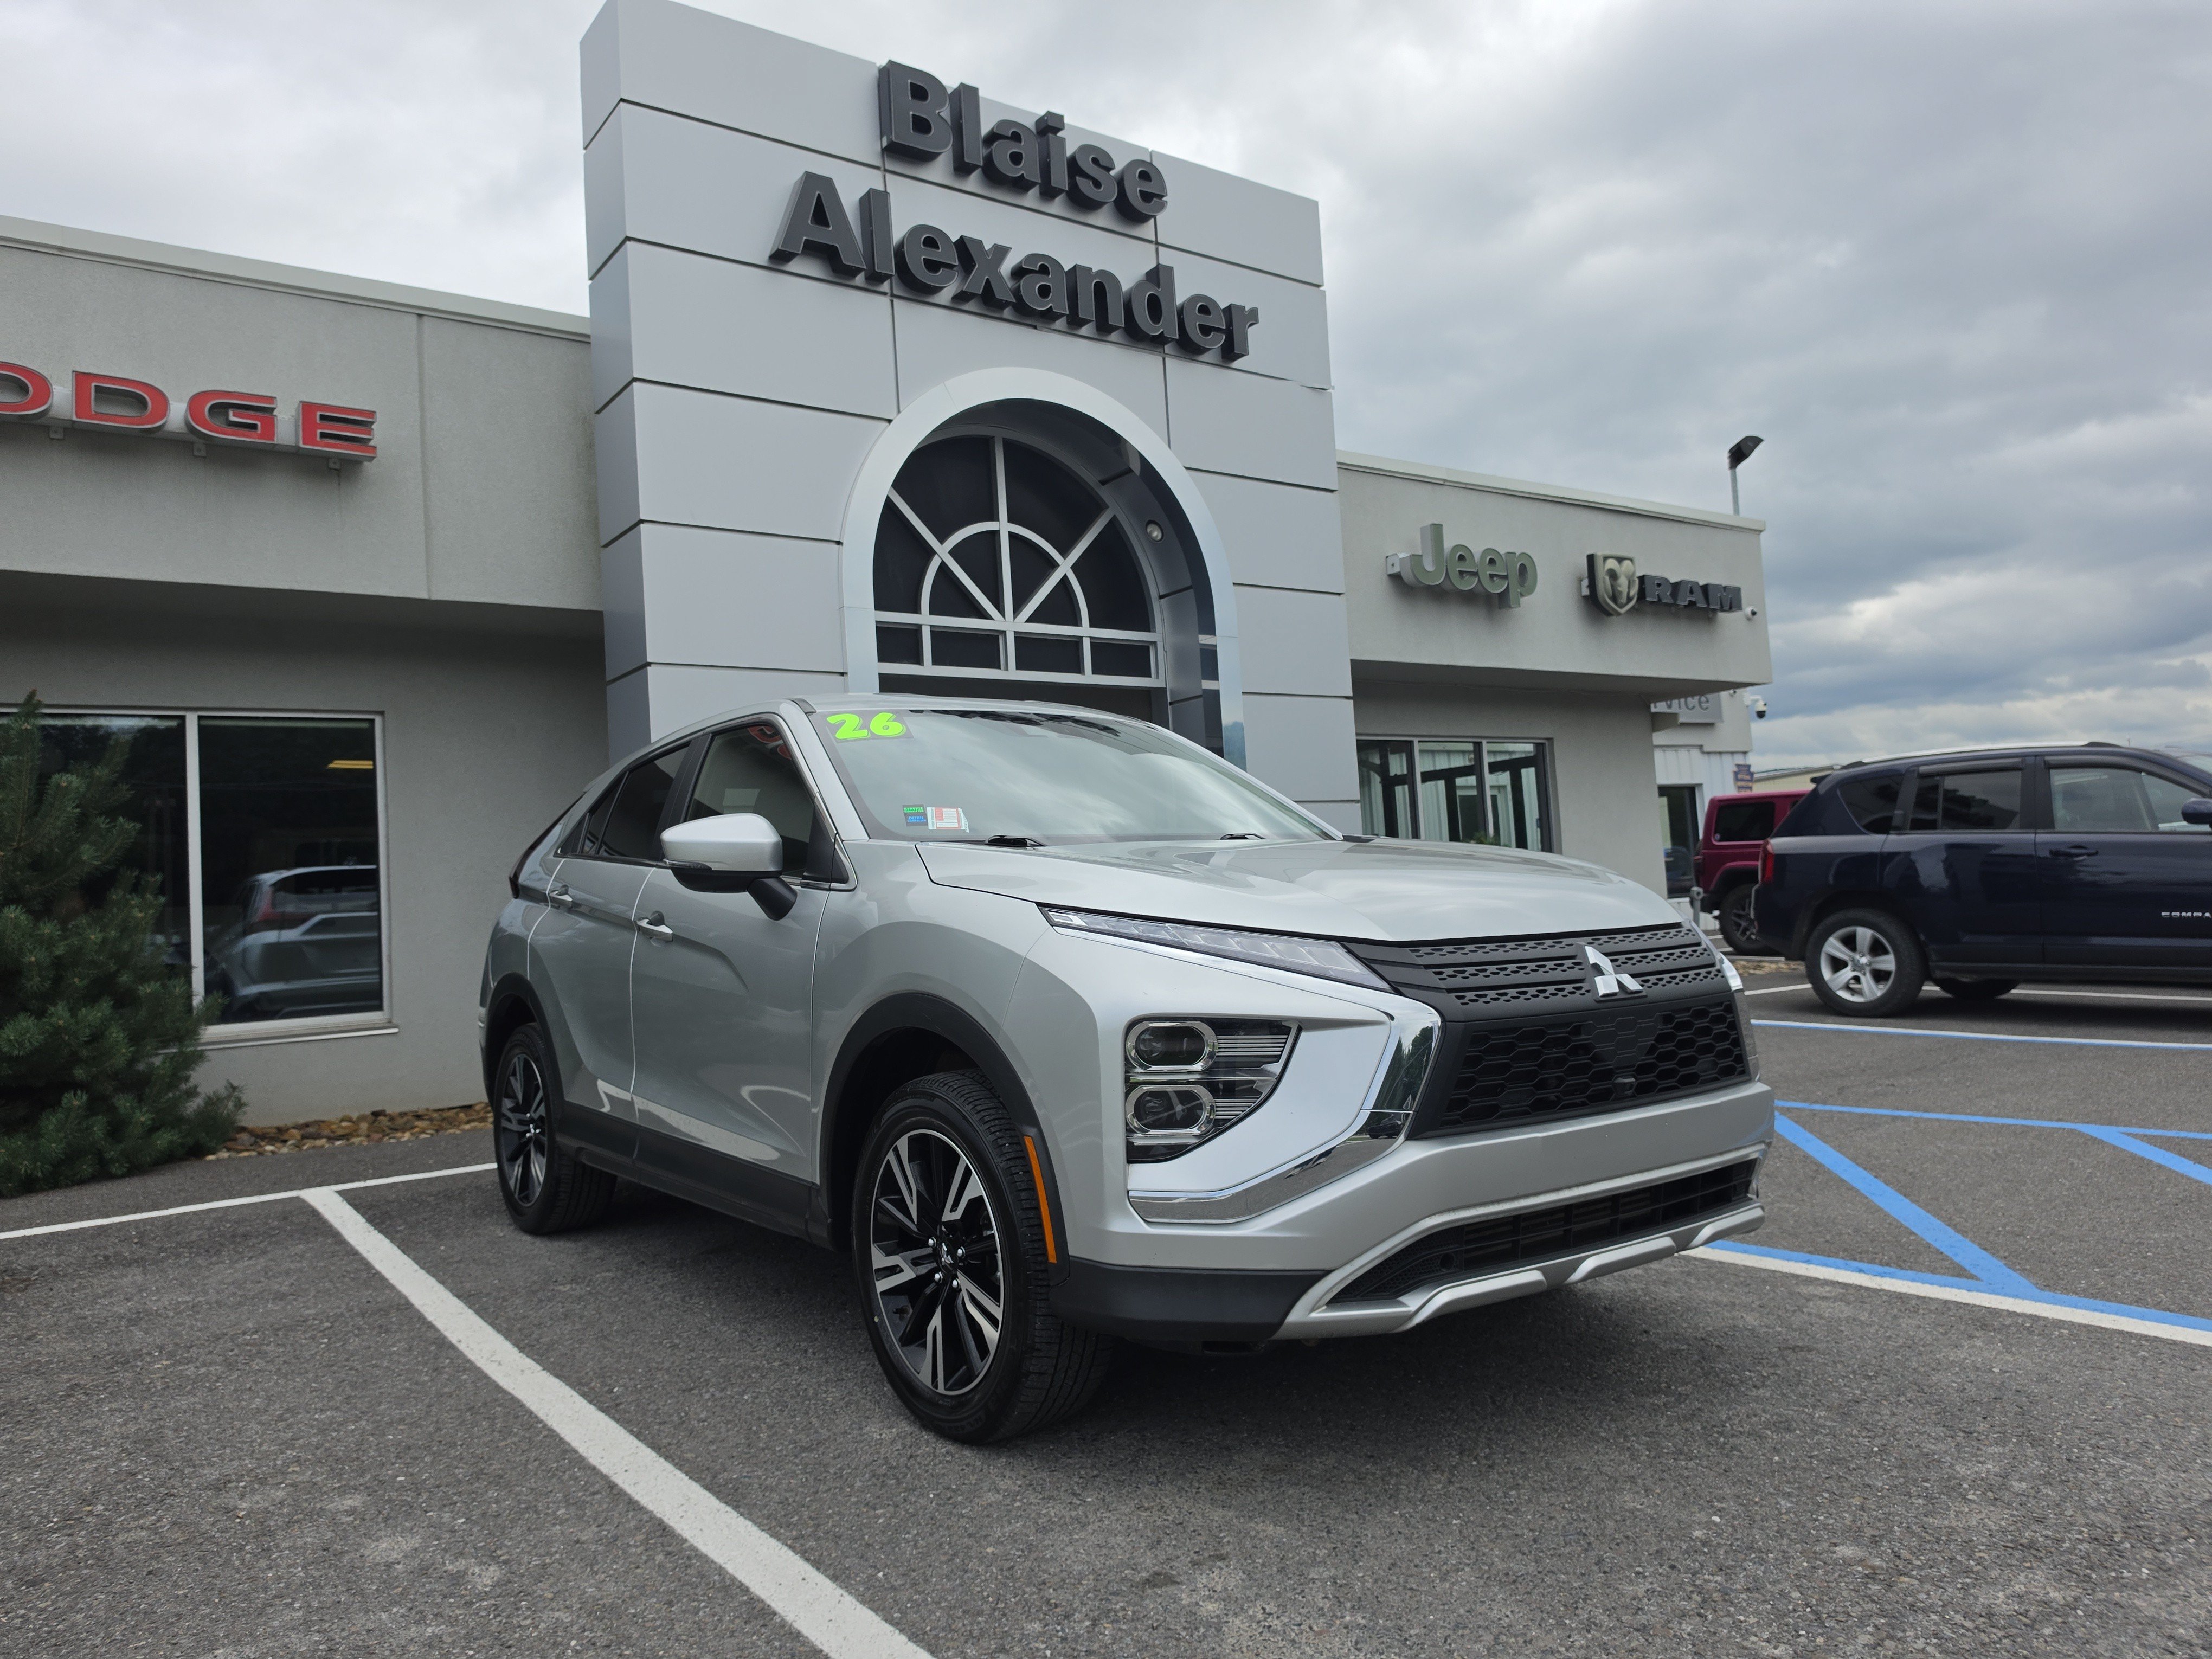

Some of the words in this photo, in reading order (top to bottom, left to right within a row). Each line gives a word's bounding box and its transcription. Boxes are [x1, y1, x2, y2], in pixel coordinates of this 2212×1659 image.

[878, 60, 1168, 223] Blaise
[769, 170, 1259, 362] Alexander
[1403, 523, 1538, 608] Jeep
[1639, 574, 1742, 612] RAM
[827, 712, 906, 740] 26
